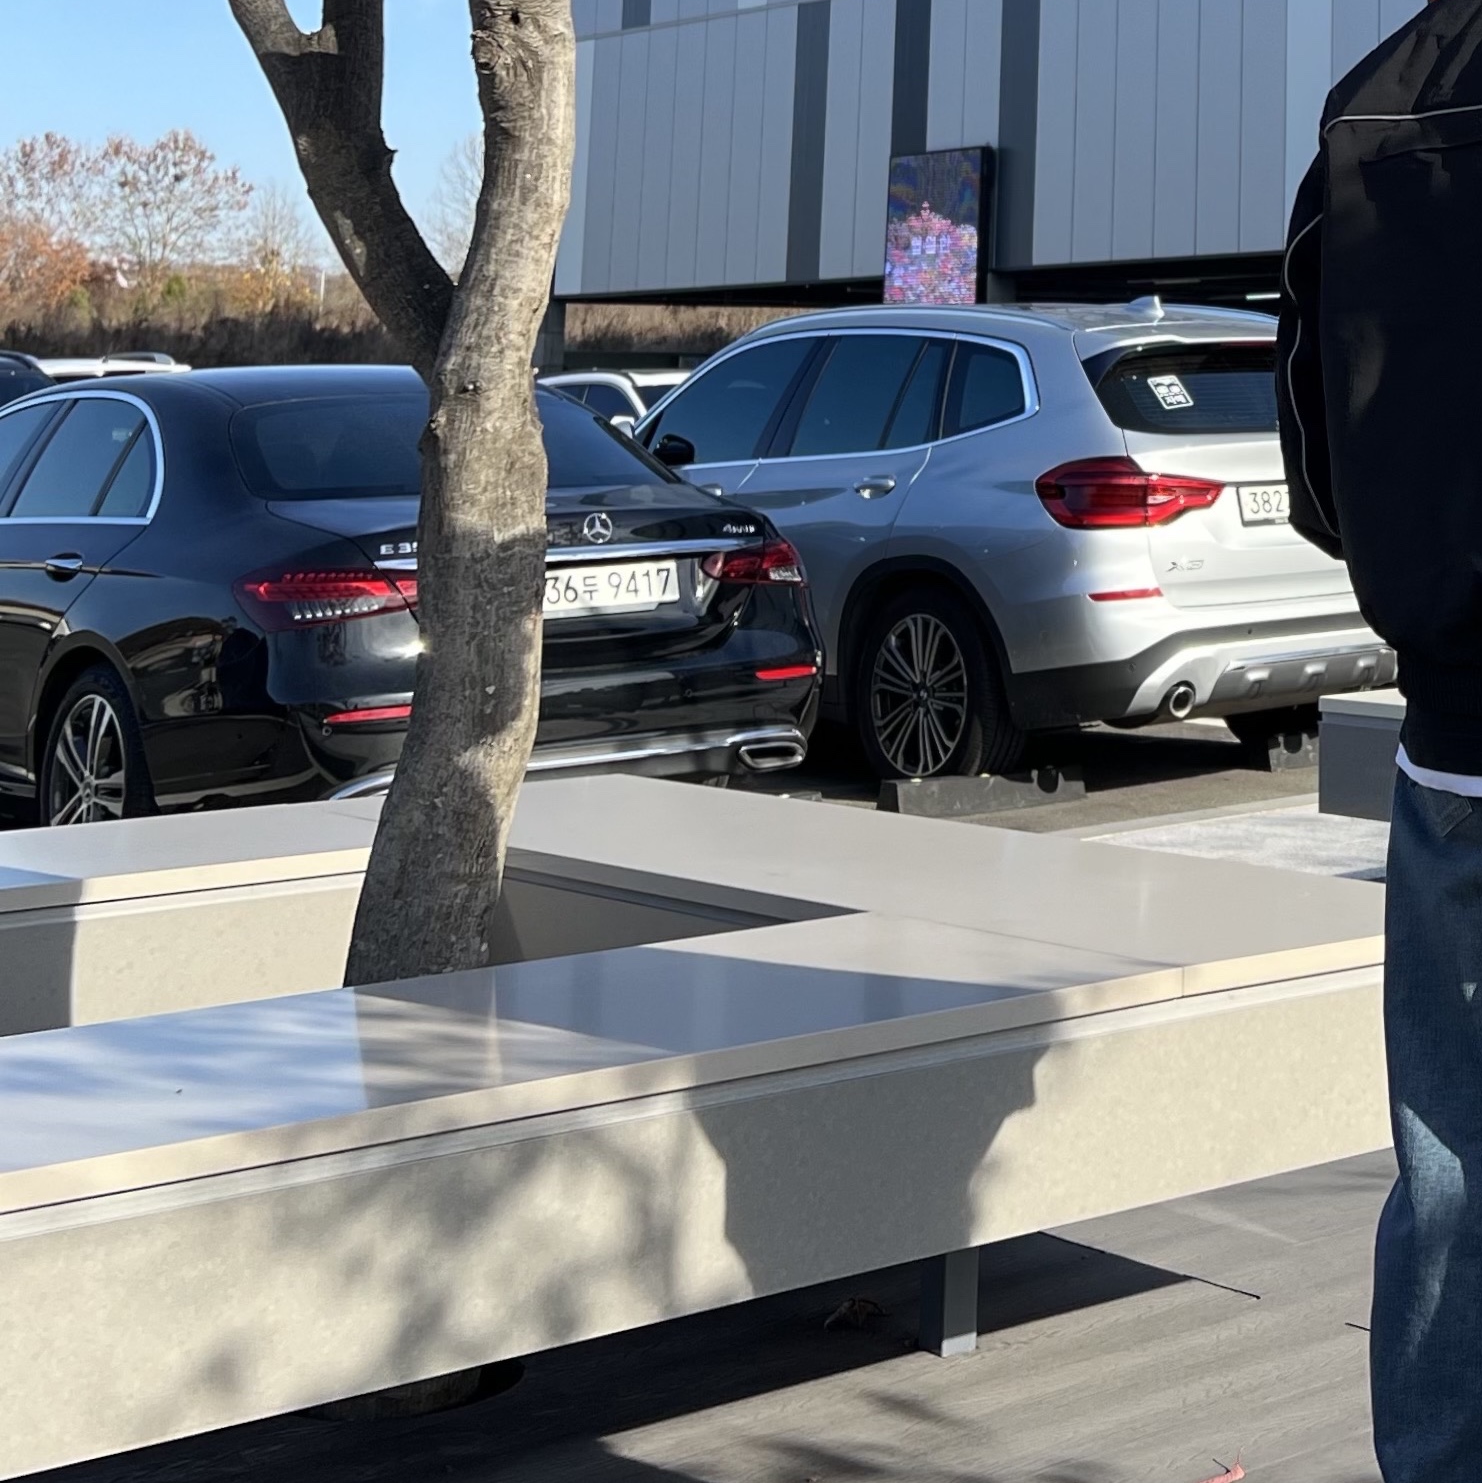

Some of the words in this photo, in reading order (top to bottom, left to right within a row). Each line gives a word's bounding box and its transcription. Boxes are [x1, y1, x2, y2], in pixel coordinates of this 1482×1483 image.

[1249, 490, 1290, 514] 382
[546, 576, 599, 604] 36두
[608, 568, 670, 599] 9417
